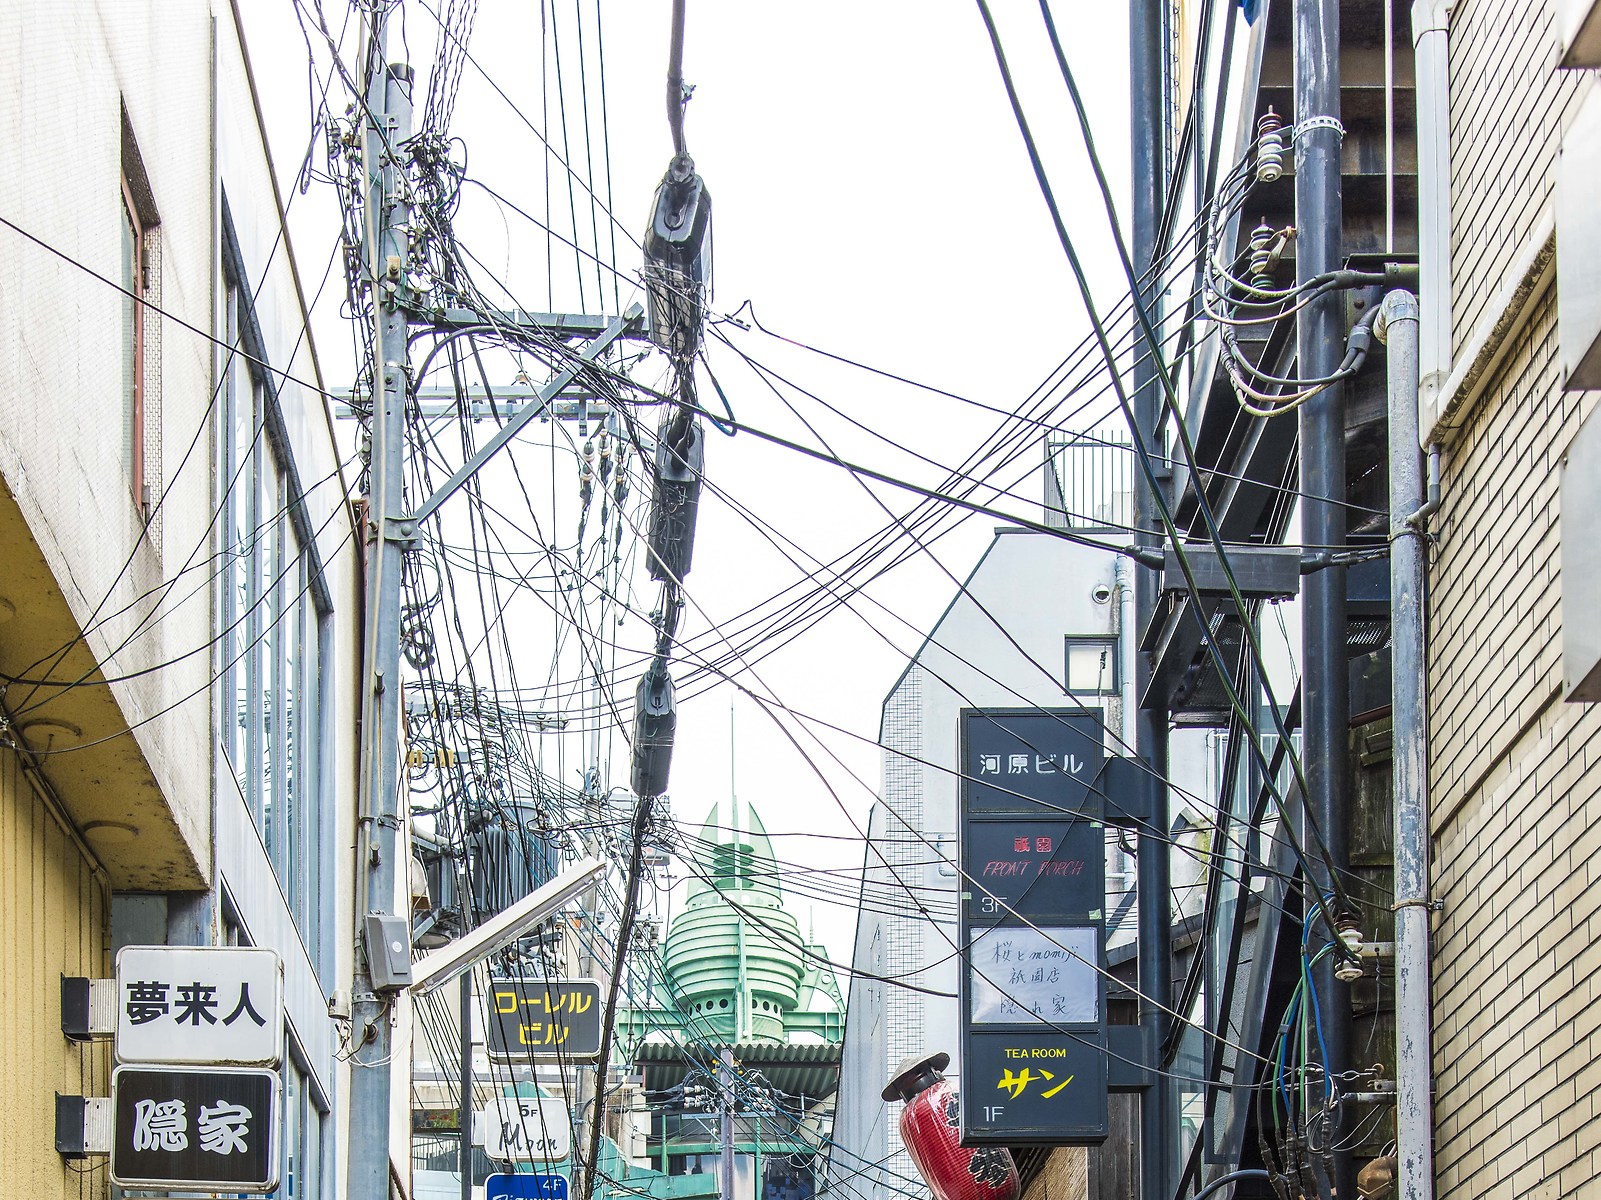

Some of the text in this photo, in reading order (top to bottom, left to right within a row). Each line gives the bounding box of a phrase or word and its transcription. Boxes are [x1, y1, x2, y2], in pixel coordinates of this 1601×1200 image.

[980, 754, 1083, 774] 河原ビル
[982, 860, 1084, 877] FRONT PORCH
[126, 981, 267, 1027] 夢来人
[494, 991, 592, 1014] ローレル
[519, 1022, 569, 1045] ビル
[1004, 1048, 1066, 1058] TEA ROOM
[997, 1067, 1074, 1100] サン
[519, 1104, 538, 1117] 5F
[983, 1106, 1004, 1122] 1F
[133, 1099, 252, 1155] 隠家
[542, 1178, 562, 1191] 4F
